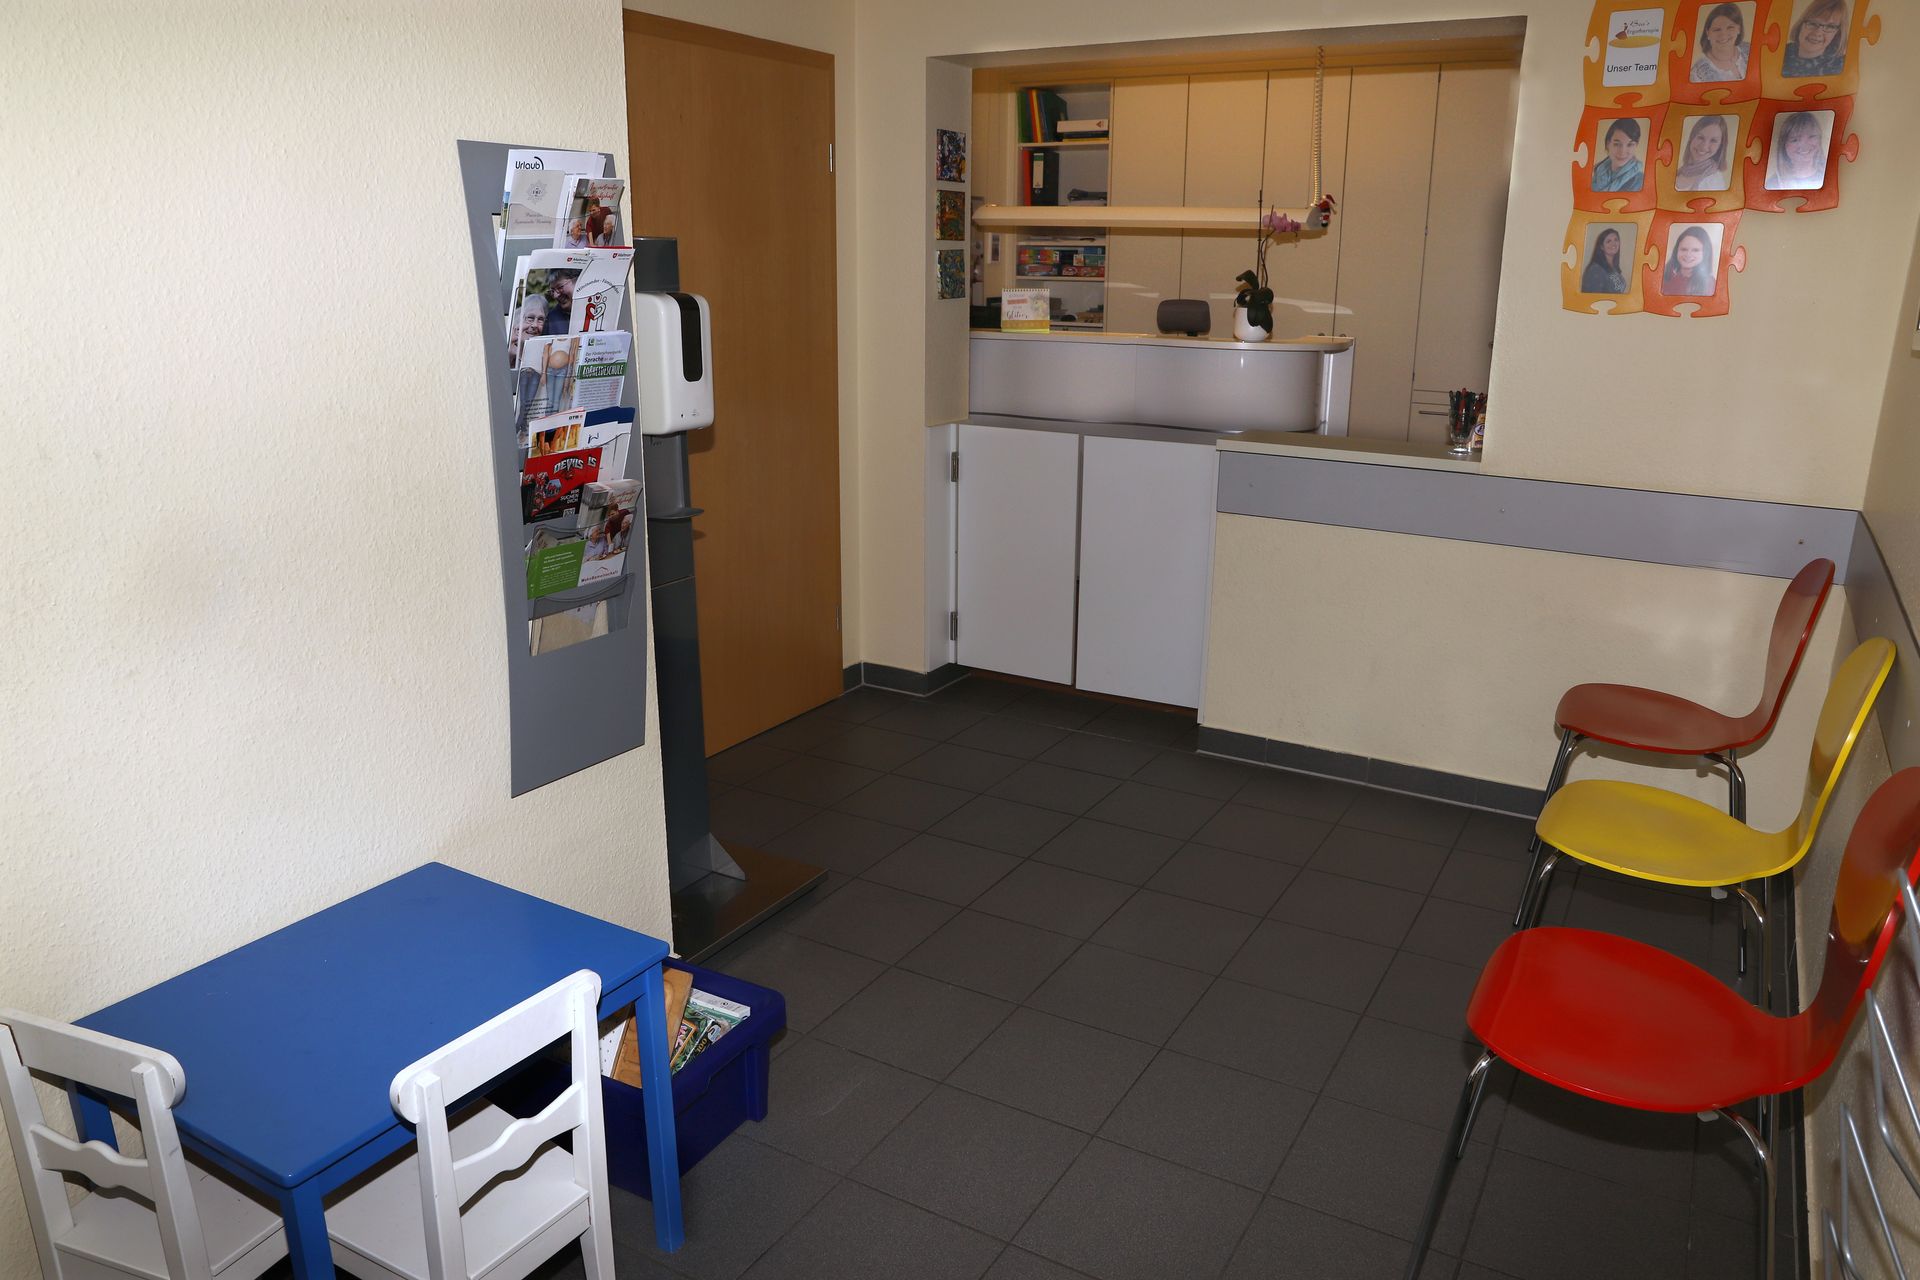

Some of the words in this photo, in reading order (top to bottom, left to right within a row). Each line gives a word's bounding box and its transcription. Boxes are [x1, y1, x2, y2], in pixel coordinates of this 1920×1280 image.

[1606, 65, 1632, 73] Unser
[1634, 63, 1657, 71] Team
[515, 160, 541, 170] Urlaub
[554, 457, 584, 473] DEVILS
